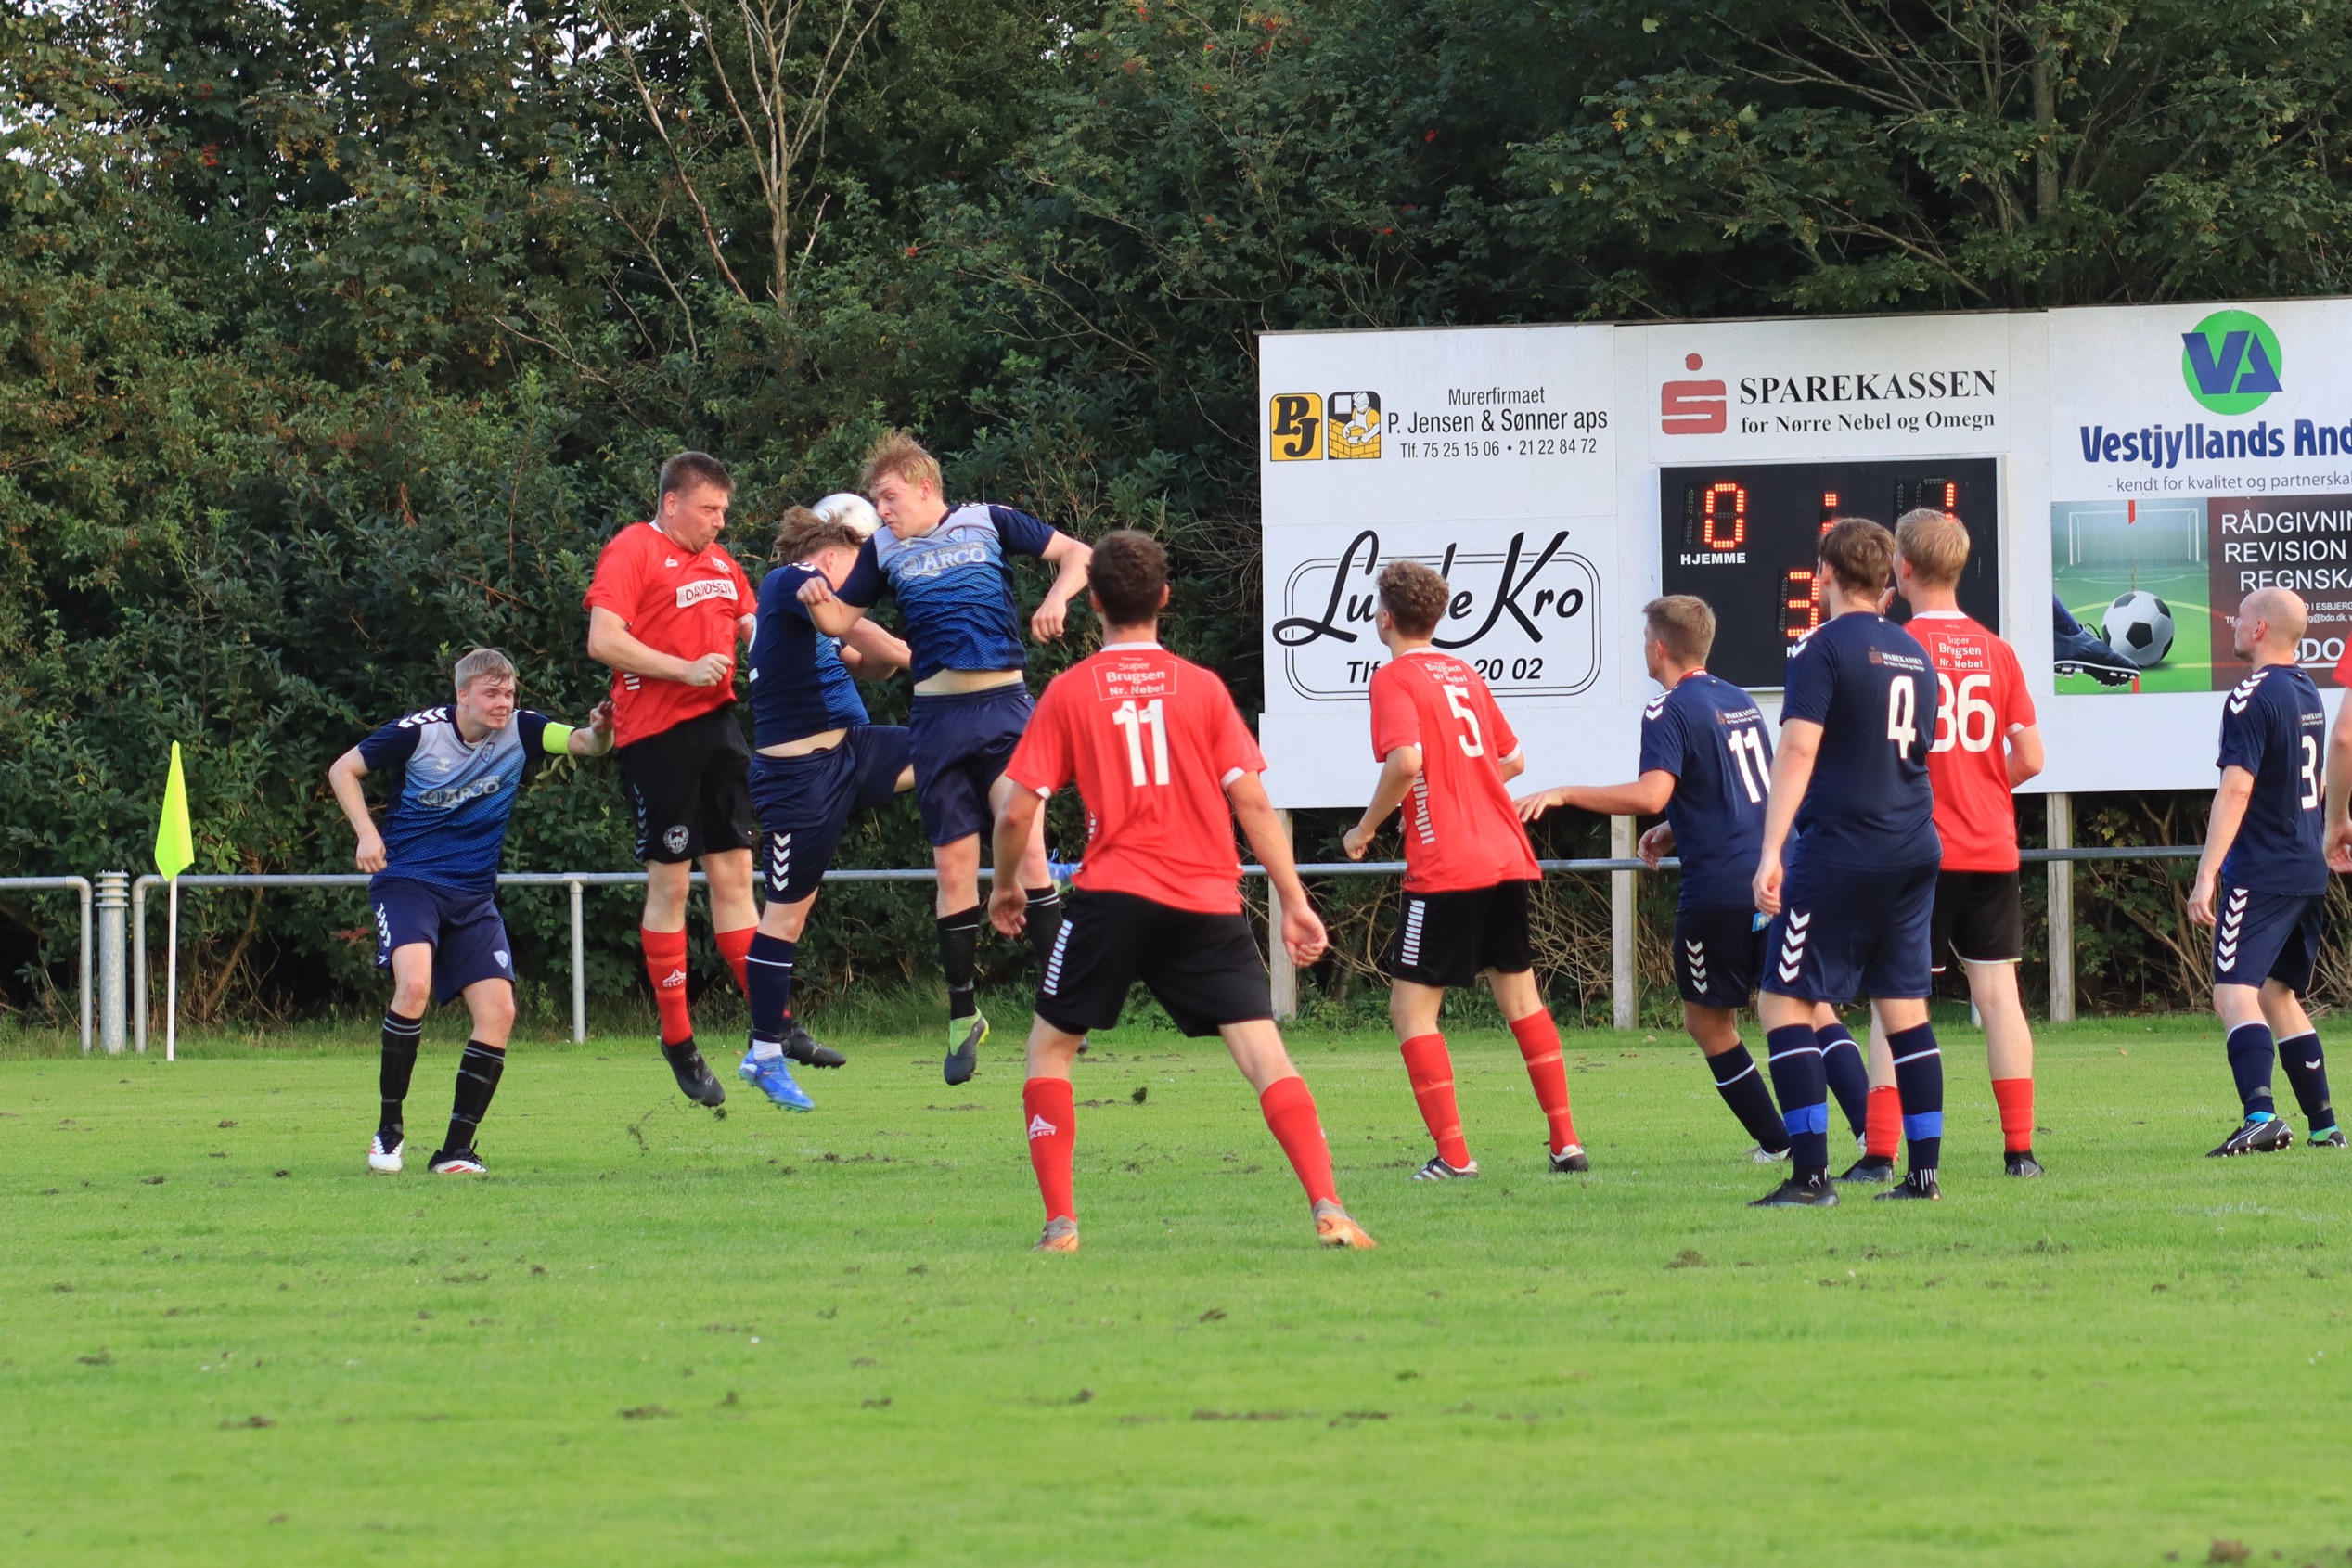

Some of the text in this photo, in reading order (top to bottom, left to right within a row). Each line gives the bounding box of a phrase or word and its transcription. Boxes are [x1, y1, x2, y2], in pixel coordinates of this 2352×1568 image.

[2181, 330, 2283, 394] VA
[1448, 386, 1545, 405] Murerfirmaet
[1740, 369, 1997, 405] SPAREKASSEN
[1388, 408, 1608, 434] P. Jensen & Sønner aps
[1741, 410, 1995, 434] for Nørre Nebel og Omegn
[1400, 438, 1597, 458] Tlf. 75 25 15 06 21 22 84 72
[2080, 421, 2285, 469] Vestjyllands
[2116, 477, 2159, 492] kendt
[2163, 476, 2183, 491] for
[2188, 474, 2242, 490] kvalitet
[2246, 478, 2266, 491] og
[1704, 482, 1745, 548] 0
[1680, 552, 1746, 565] HJEMME
[2225, 539, 2346, 563] REVISION
[1272, 529, 1584, 649] Lue Kro
[2240, 567, 2352, 592] REGNSK
[1787, 571, 1820, 637] 3
[1938, 642, 1982, 659] Brugsen
[1947, 635, 1970, 646] Super
[1117, 662, 1150, 672] Super
[1511, 658, 1544, 680] 02
[1939, 658, 1983, 668] Nr. Nebel
[1105, 671, 1166, 684] Brugsen
[1109, 683, 1165, 696] Nr. Nebel
[1443, 684, 1484, 758] 5
[1887, 675, 1916, 759] 4
[1112, 699, 1170, 787] 11
[1728, 726, 1771, 803] 11
[2302, 735, 2318, 809] 3
